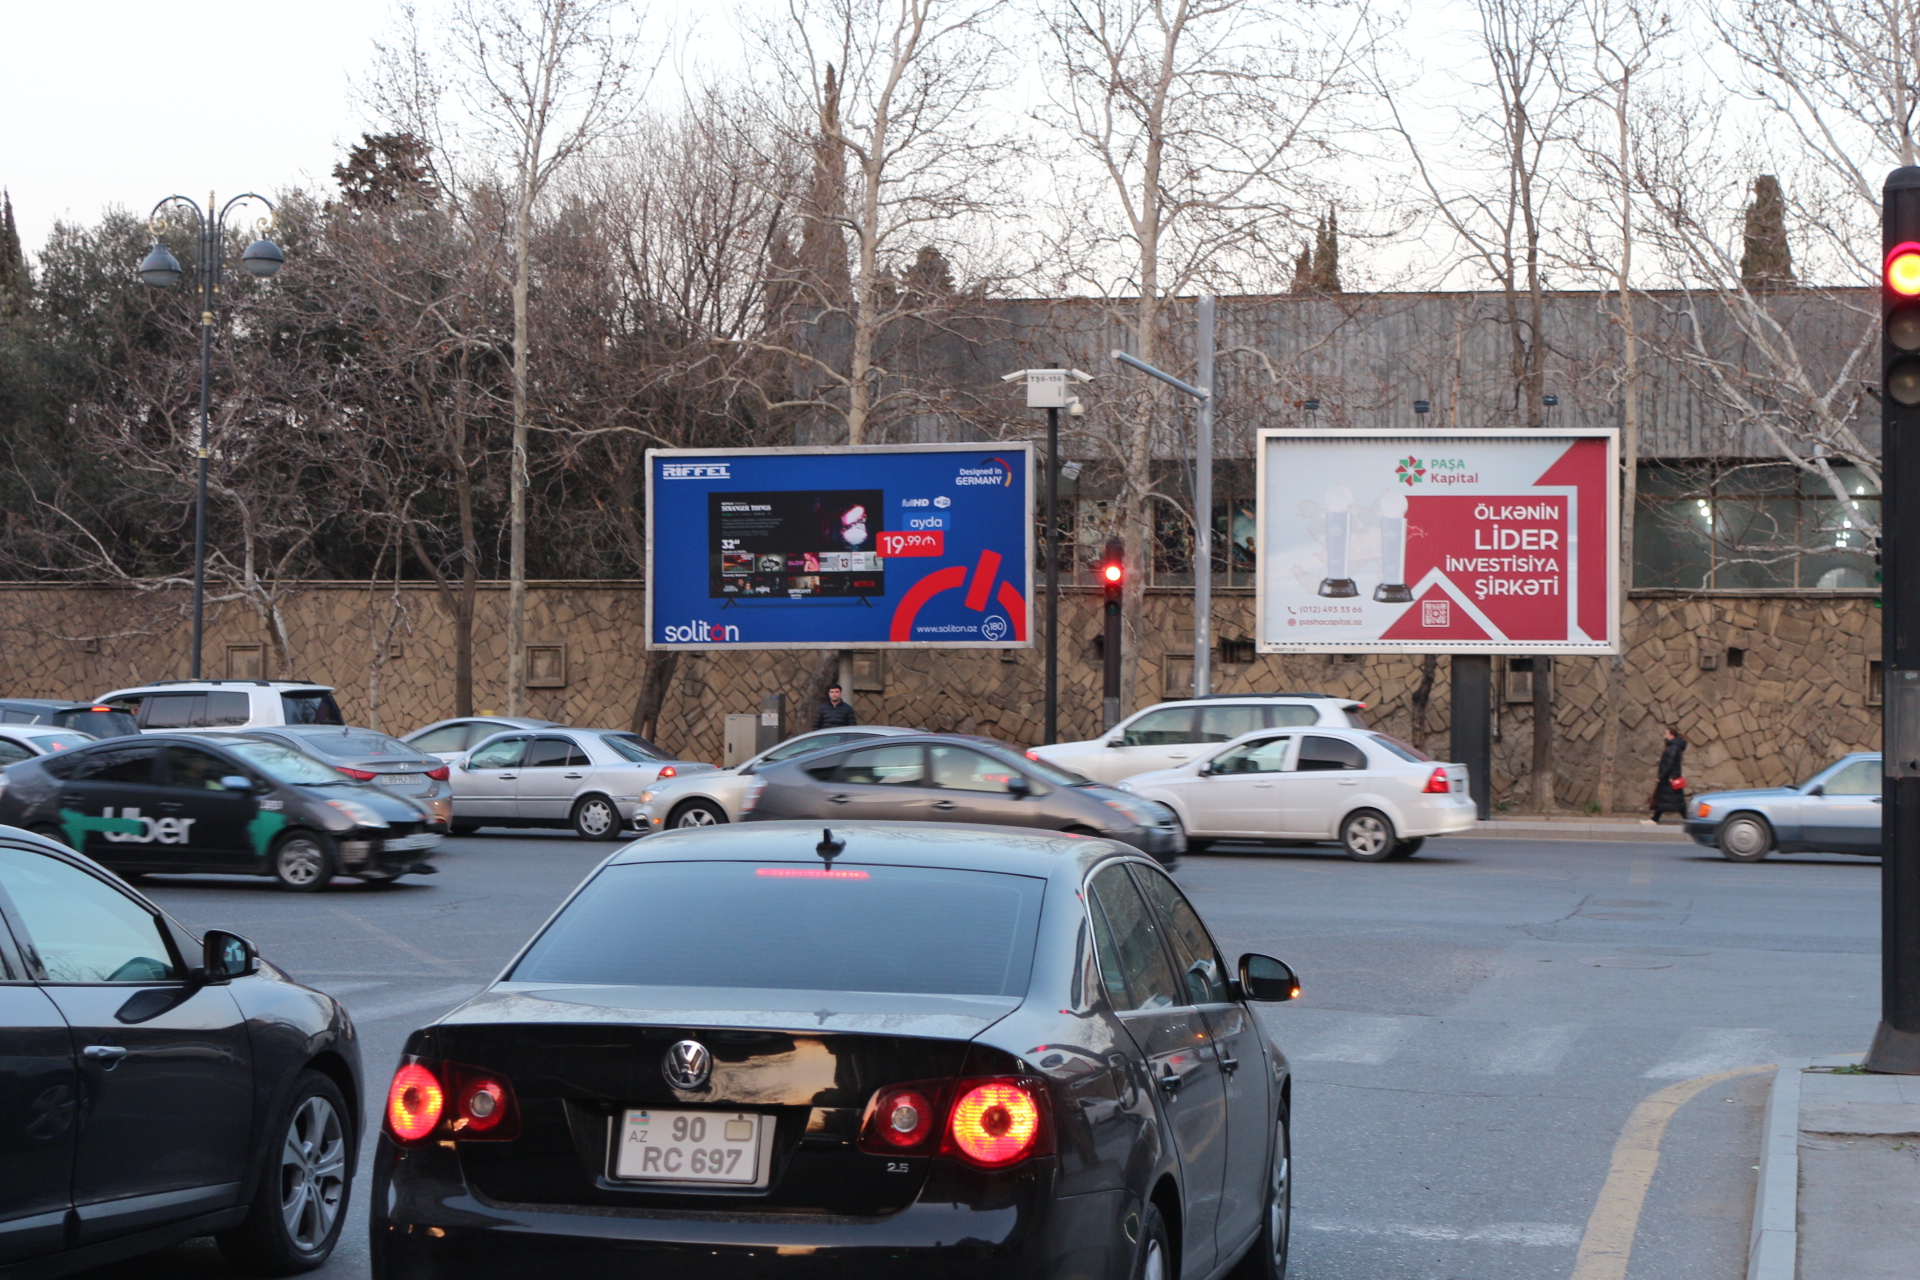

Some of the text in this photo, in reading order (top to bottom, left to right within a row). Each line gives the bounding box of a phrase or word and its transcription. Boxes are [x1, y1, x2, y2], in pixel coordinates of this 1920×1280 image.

[959, 467, 1002, 477] Designed in
[1431, 459, 1465, 471] PAŞA
[955, 476, 1002, 486] GERMANY
[1431, 473, 1478, 485] Kapital
[1474, 502, 1559, 520] ÖLKƏNİN
[910, 516, 943, 530] ayda
[1474, 523, 1559, 550] LİDER
[1446, 554, 1559, 572] İNVESTİSİYA
[1474, 575, 1559, 600] ŞİRKƏTİ
[664, 620, 740, 642] soliton
[916, 624, 978, 633] www.soliton.az
[989, 622, 1004, 631] 180
[628, 1130, 649, 1143] AZ
[672, 1116, 707, 1143] 90
[642, 1146, 743, 1175] RC 697
